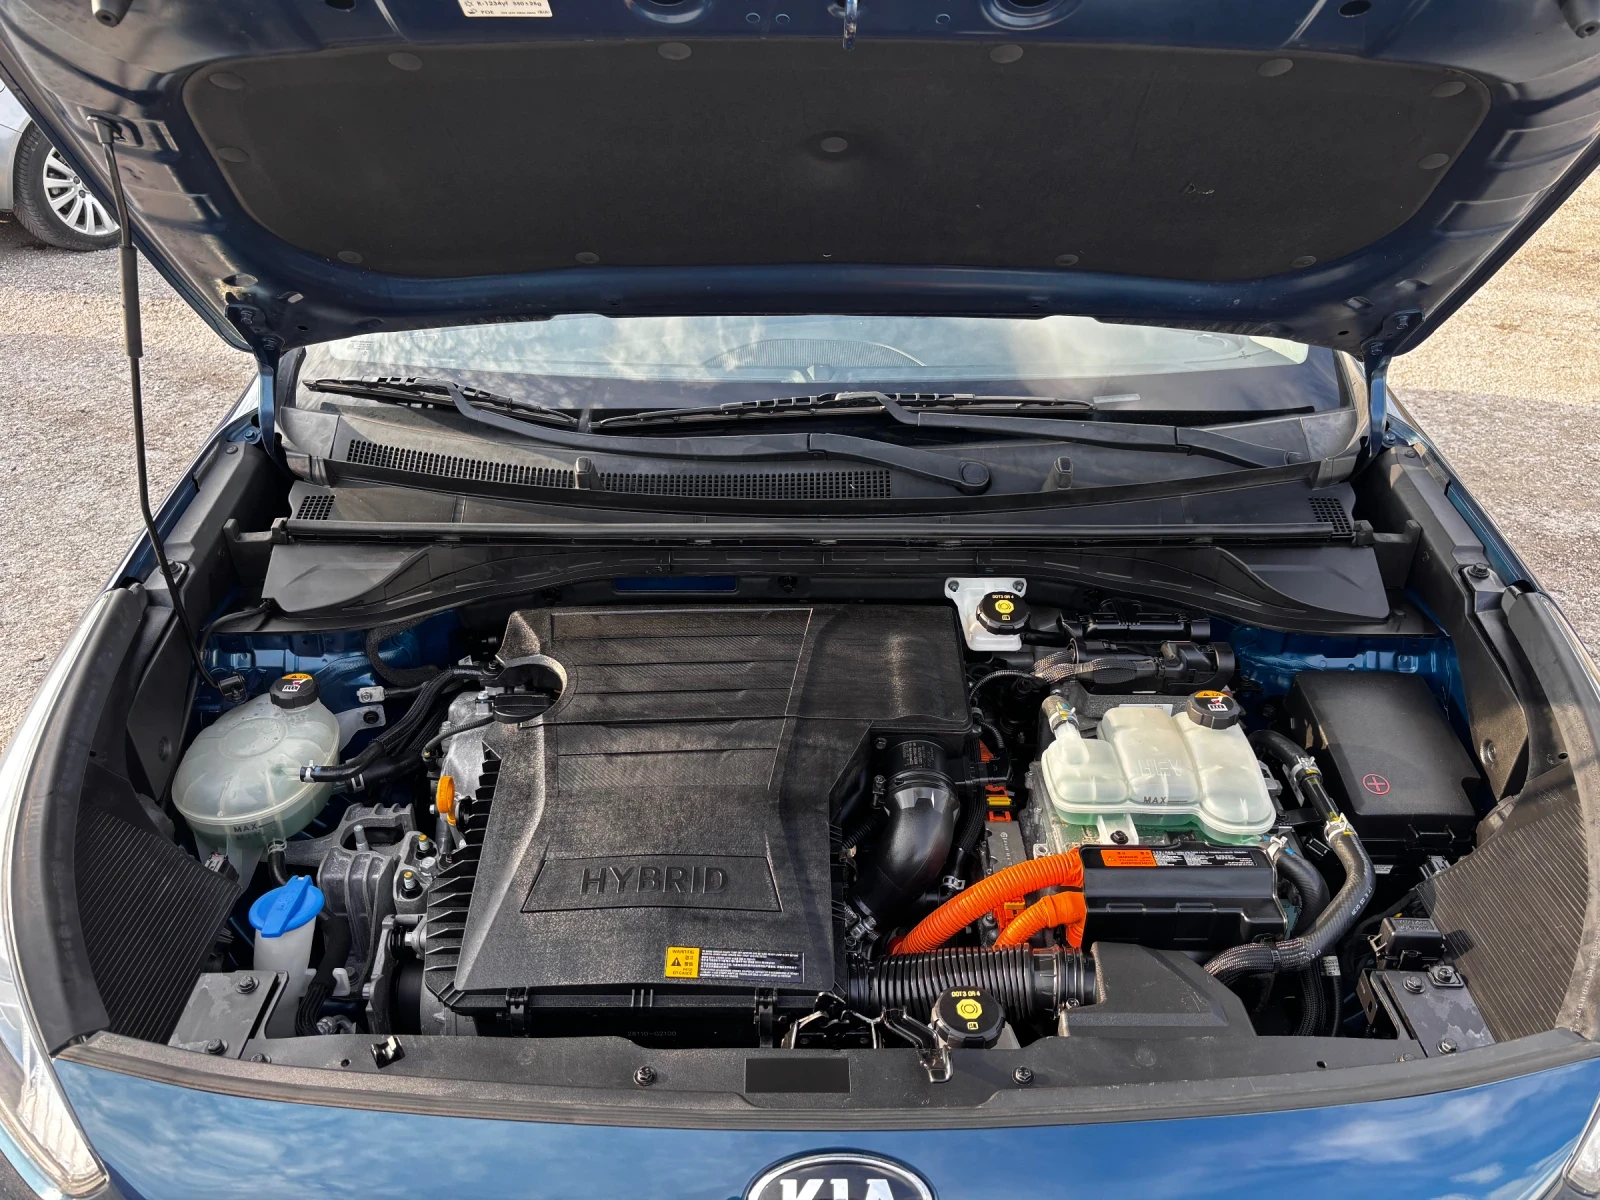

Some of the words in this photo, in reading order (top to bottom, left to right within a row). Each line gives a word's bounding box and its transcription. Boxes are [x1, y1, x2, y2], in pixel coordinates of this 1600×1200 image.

[1143, 796, 1167, 804] MAX
[233, 823, 258, 833] MAX
[579, 866, 729, 894] HYBRID
[779, 1178, 895, 1200] KIA
